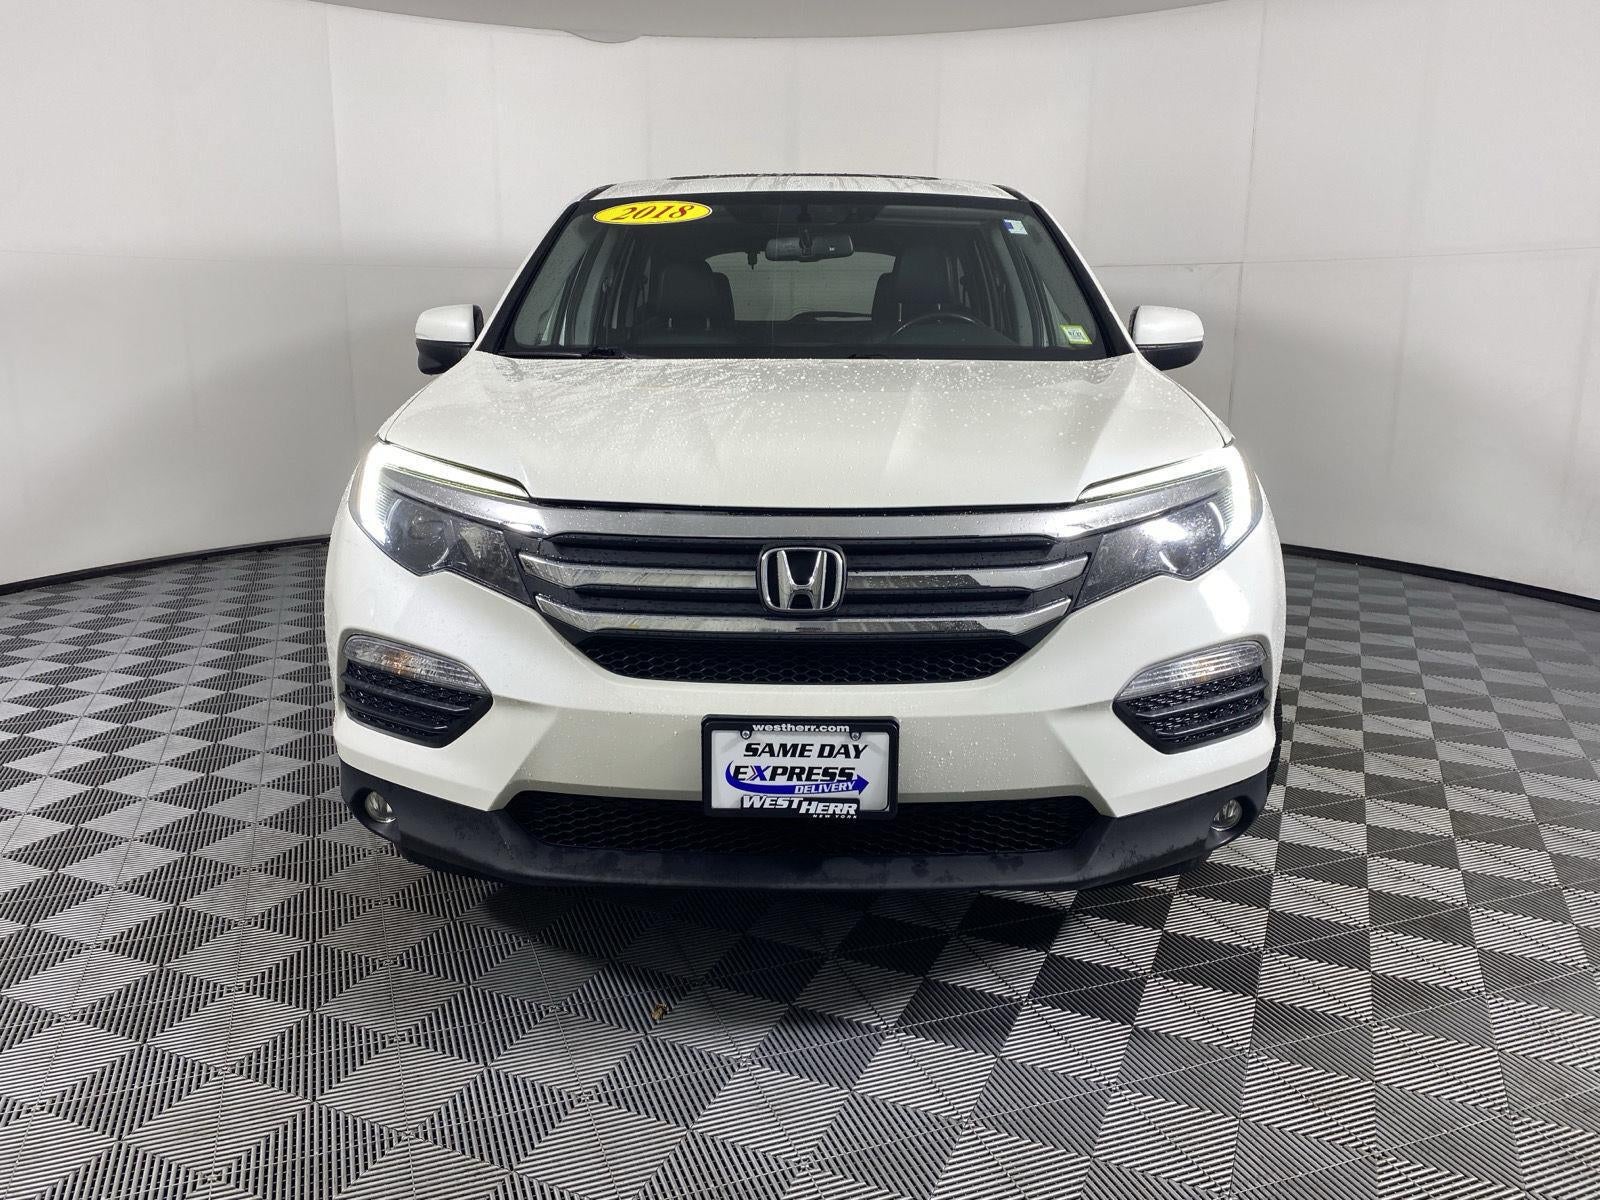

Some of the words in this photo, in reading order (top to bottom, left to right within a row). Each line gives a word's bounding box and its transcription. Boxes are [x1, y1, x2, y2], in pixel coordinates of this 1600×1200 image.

[611, 205, 695, 220] 2018
[752, 723, 850, 732] westherr.com
[744, 743, 814, 758] SAME
[817, 744, 868, 759] DAY
[733, 765, 856, 781] EXPRESS
[795, 781, 856, 794] DELIVERY
